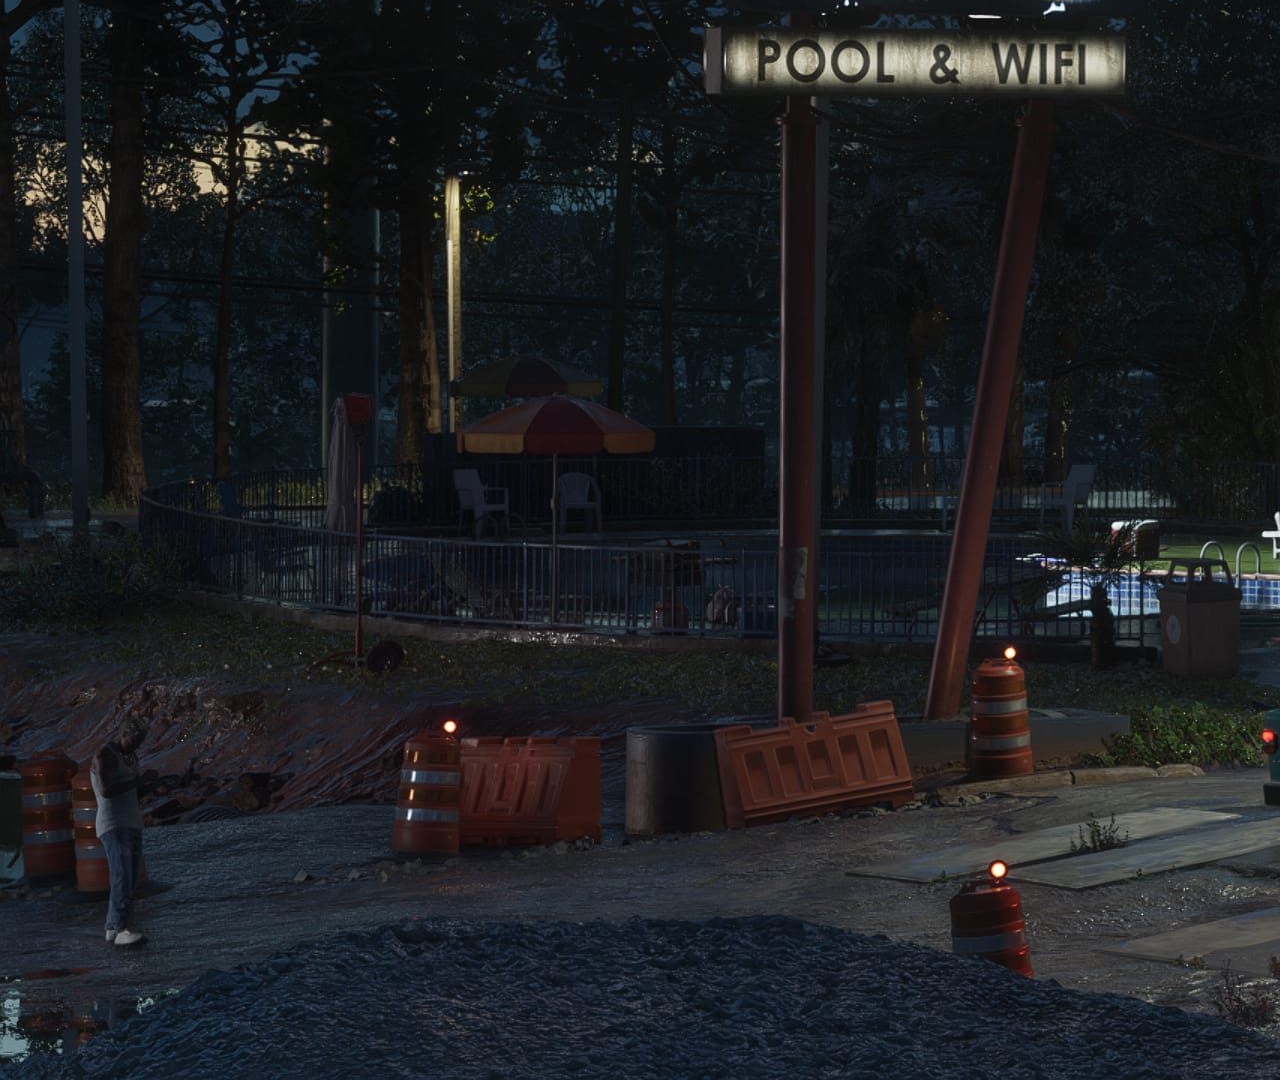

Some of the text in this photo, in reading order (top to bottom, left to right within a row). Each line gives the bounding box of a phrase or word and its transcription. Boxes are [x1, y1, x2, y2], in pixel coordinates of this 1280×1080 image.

[757, 39, 1087, 86] POOL & WIFI
